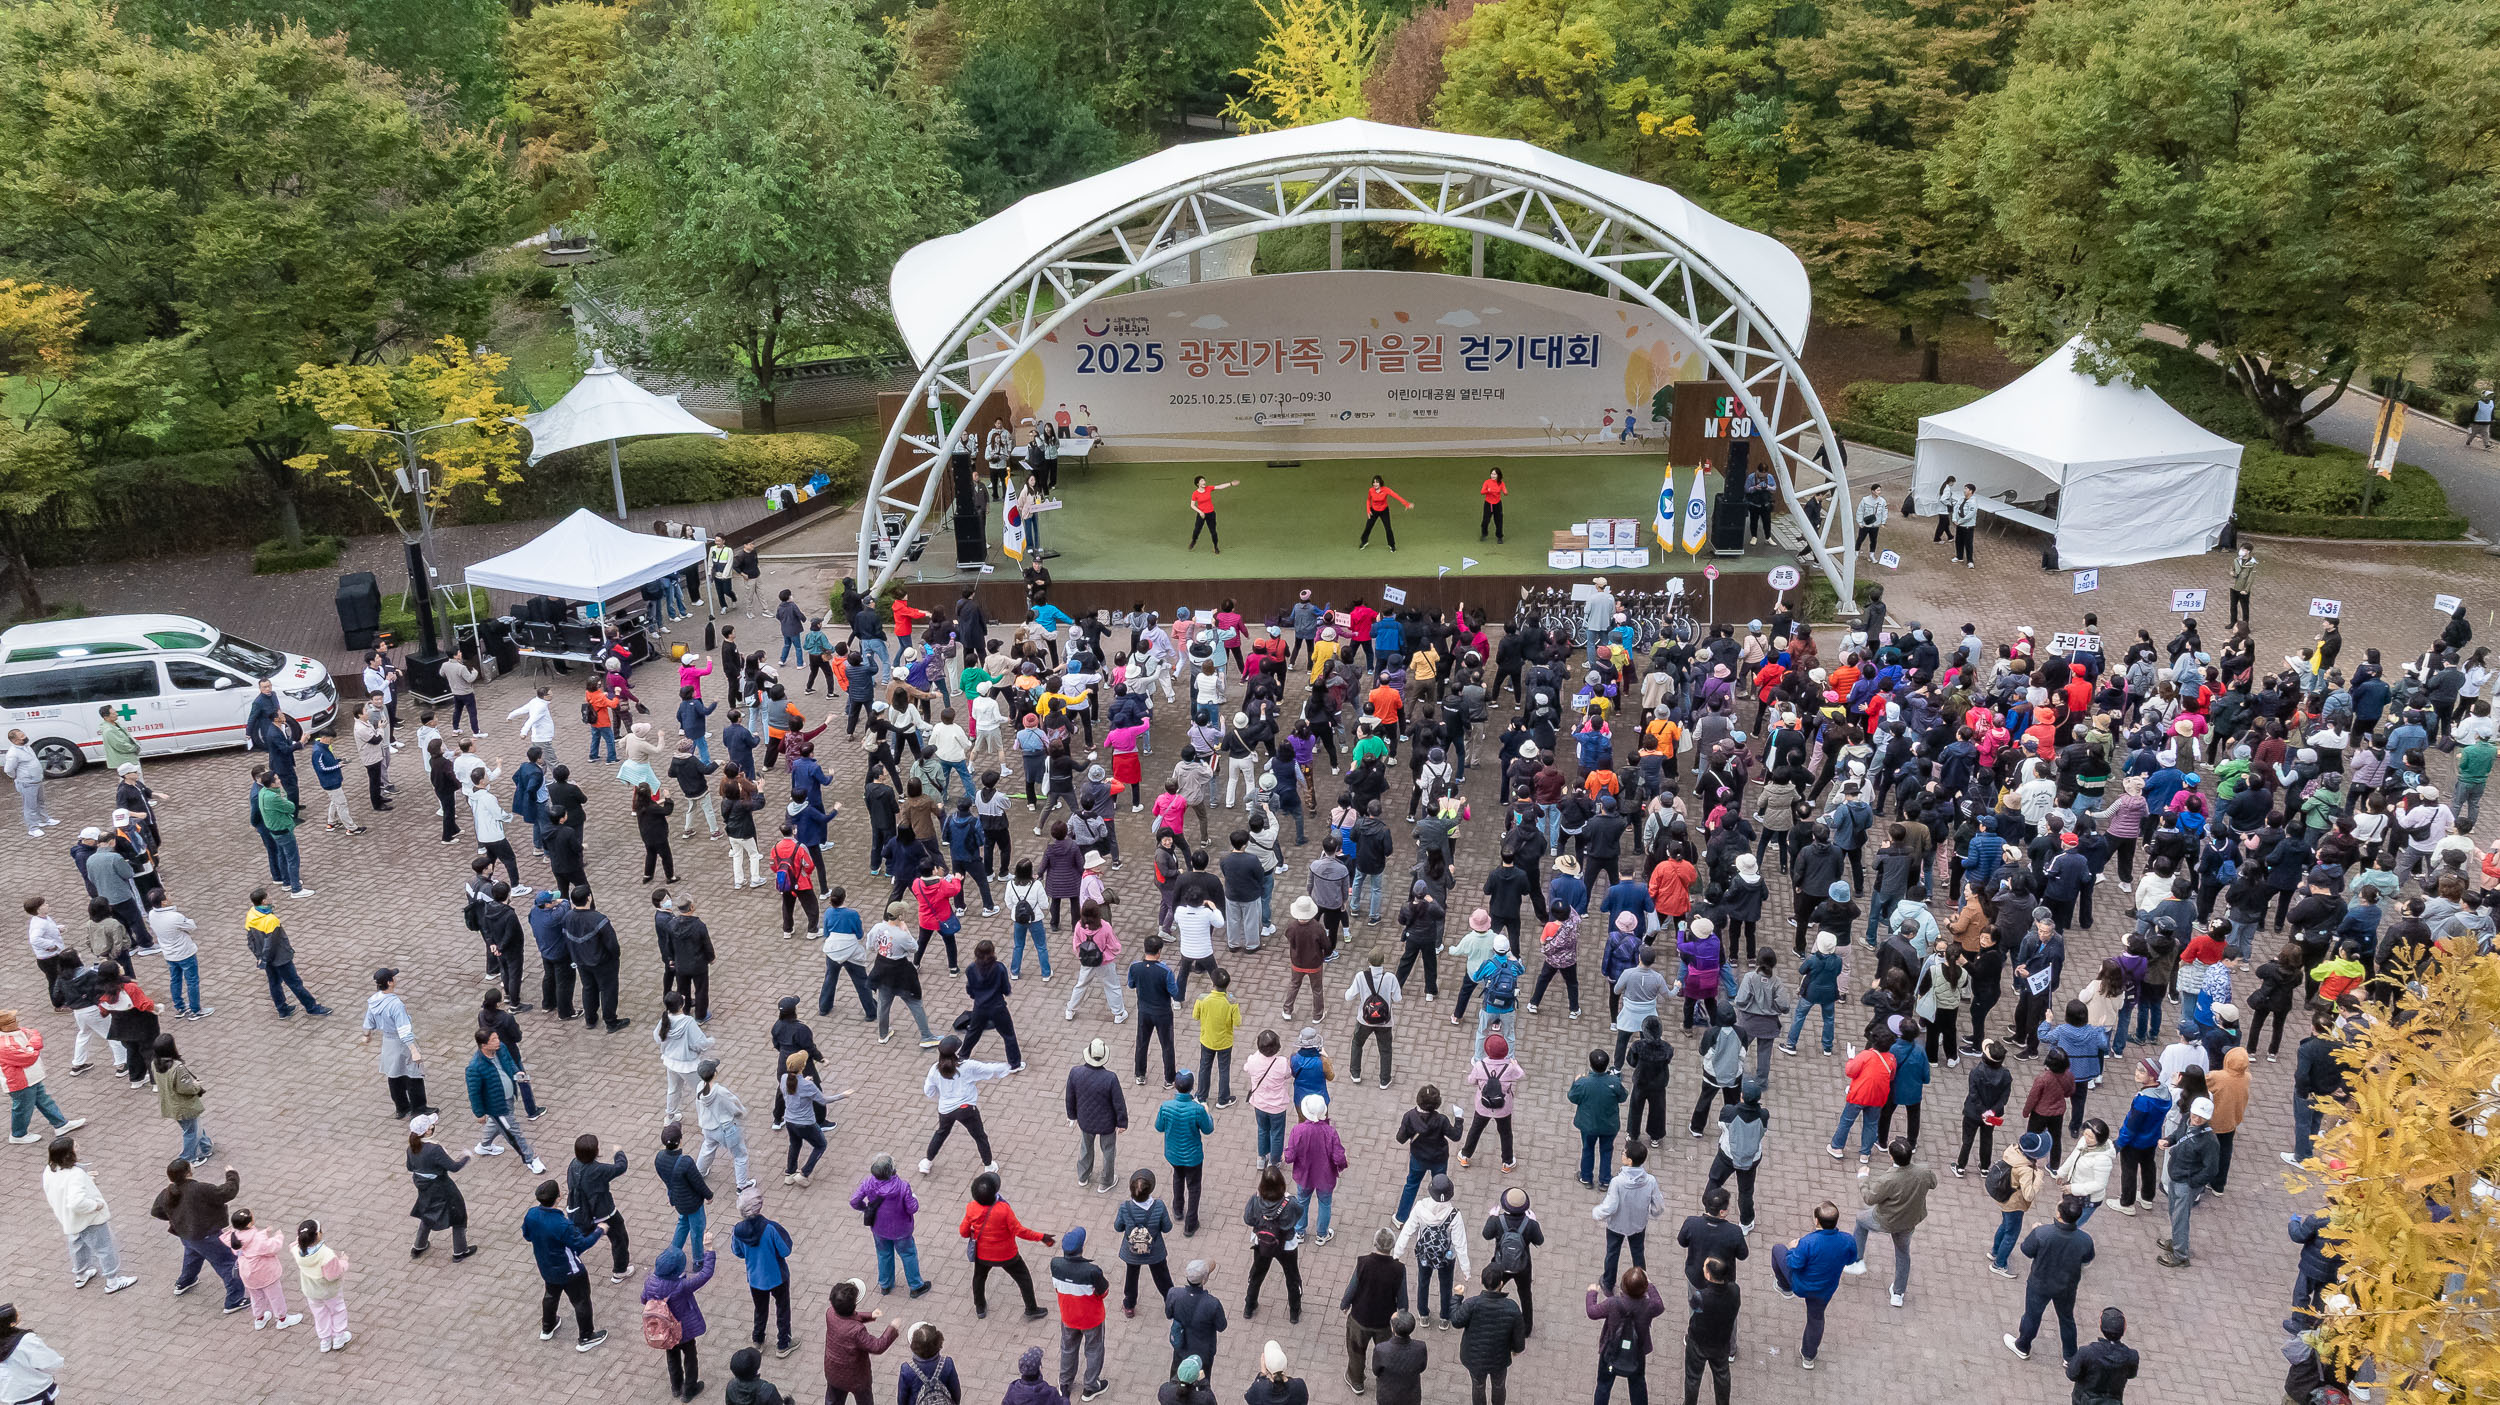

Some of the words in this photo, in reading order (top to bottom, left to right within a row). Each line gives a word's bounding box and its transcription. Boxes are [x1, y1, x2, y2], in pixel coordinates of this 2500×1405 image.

[1113, 324, 1150, 336] 행복광진
[1076, 343, 1164, 374] 2025
[1178, 339, 1324, 377] 광진가족
[1337, 334, 1444, 374] 가을길
[1459, 333, 1600, 373] 걷기대회
[1169, 393, 1256, 405] 2025.10.25.(토)
[1259, 391, 1332, 404] 07:30~09:30
[1387, 389, 1456, 401] 어린이대공원
[1459, 388, 1505, 401] 열린무대
[1776, 570, 1793, 580] 능동
[2175, 600, 2202, 608] 구의3동
[2055, 635, 2099, 650] 구의2동
